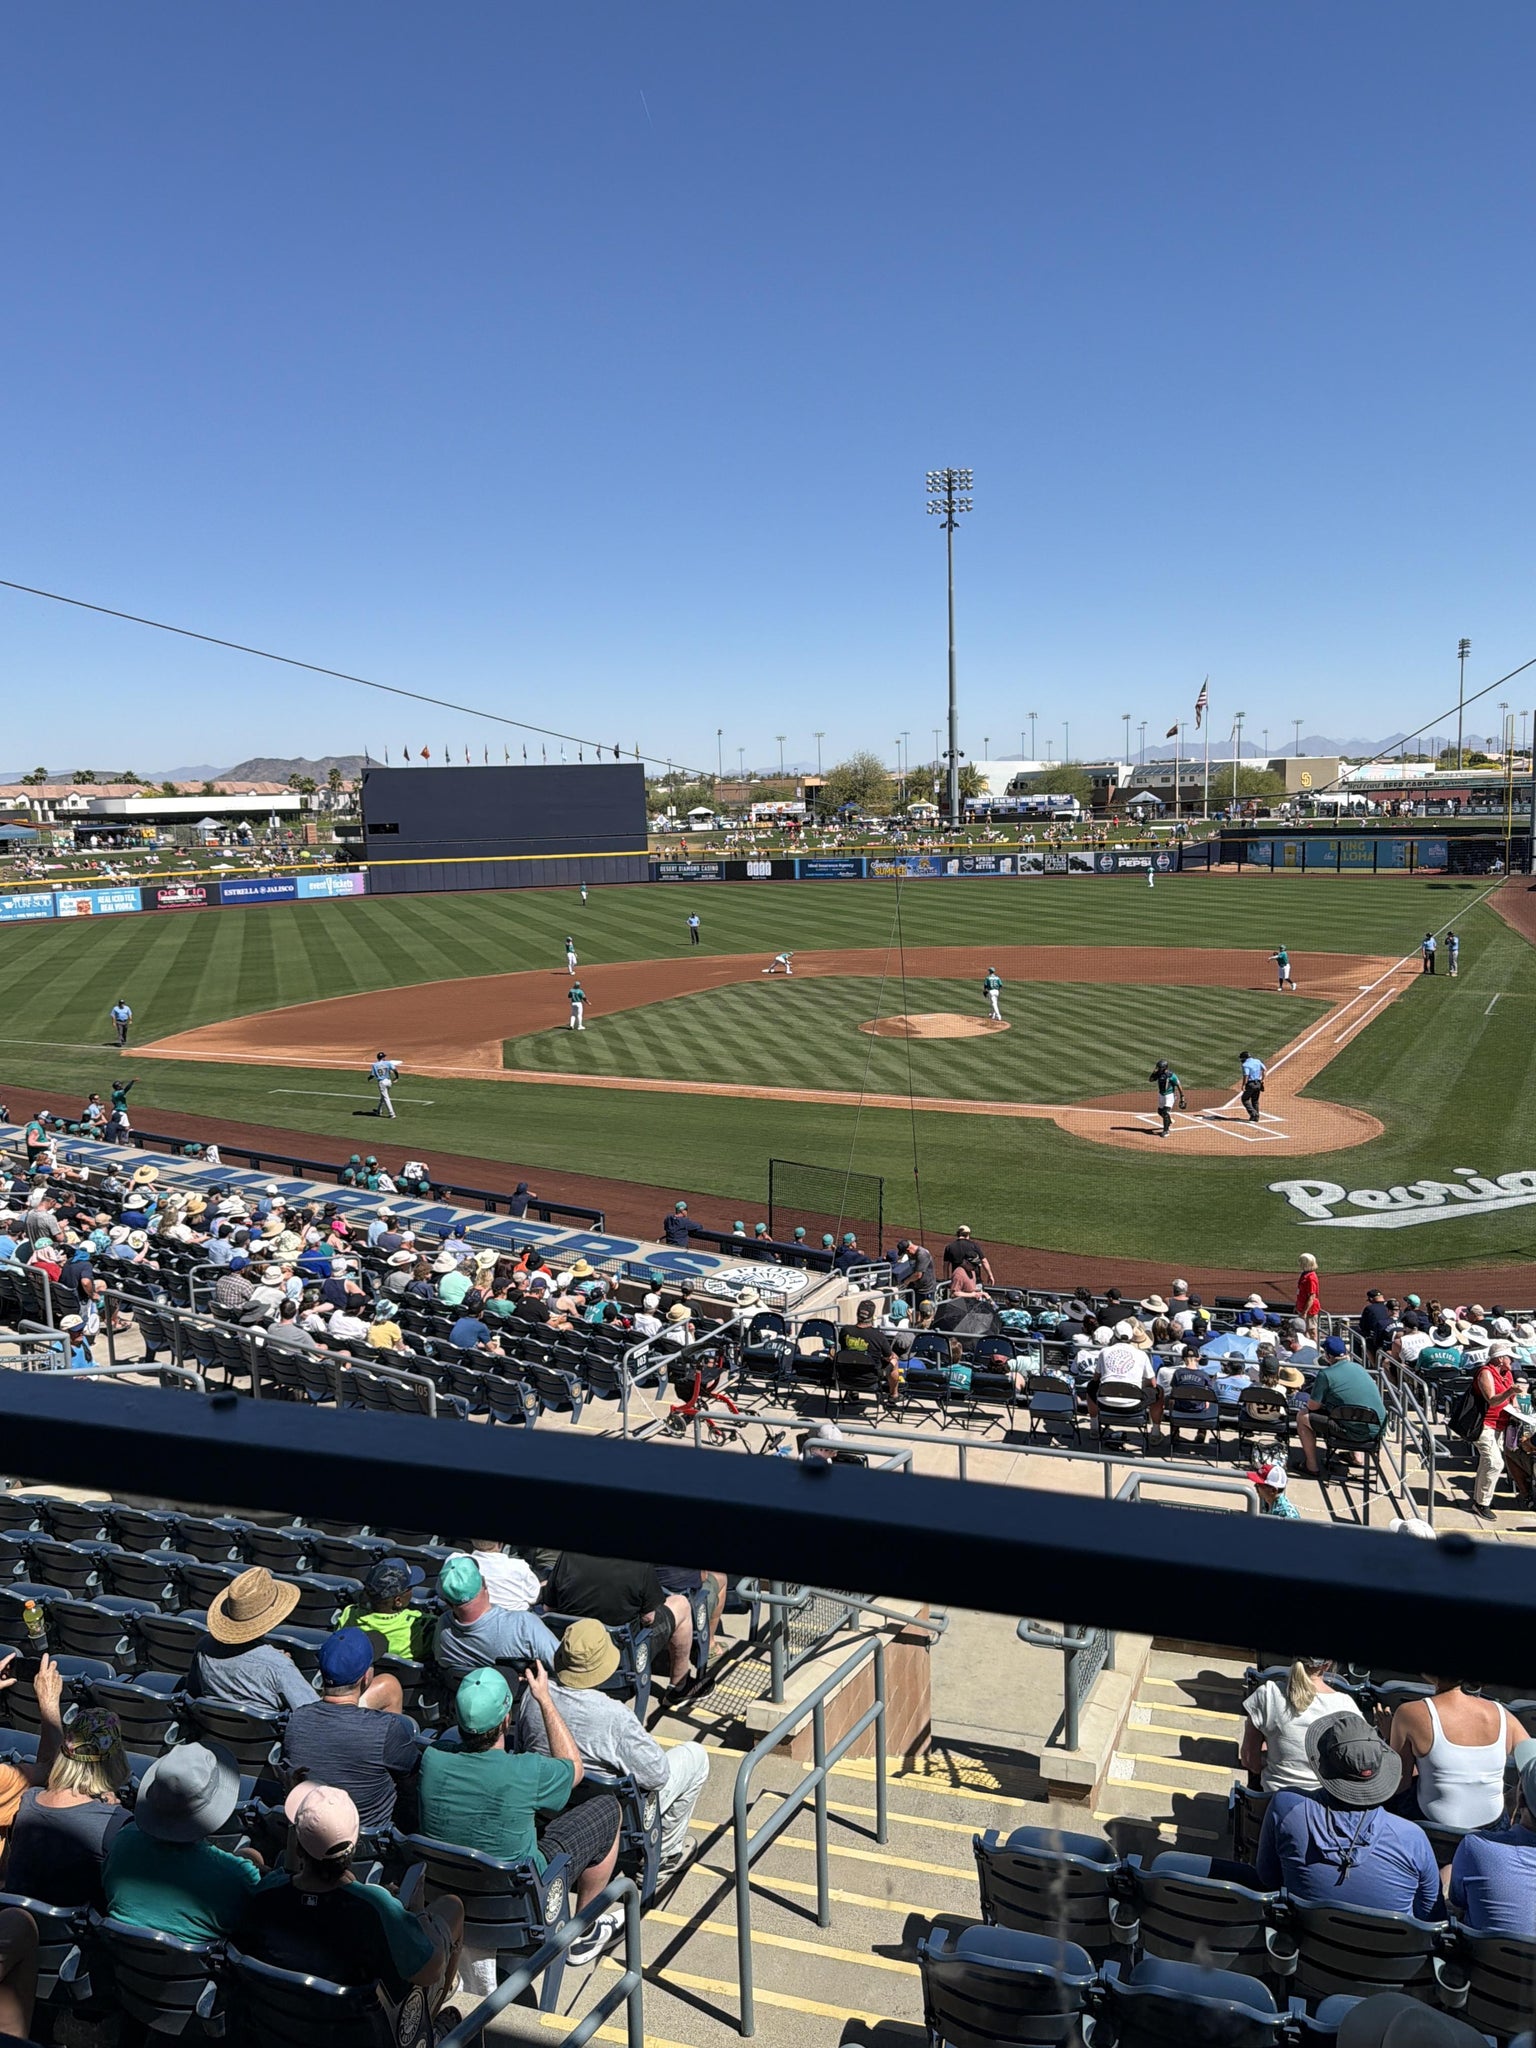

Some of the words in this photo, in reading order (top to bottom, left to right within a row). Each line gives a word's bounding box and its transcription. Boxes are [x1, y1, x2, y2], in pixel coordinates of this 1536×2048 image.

[874, 866, 907, 876] SUMMER
[223, 887, 259, 896] ESTRELLA
[266, 885, 295, 894] JALISCO
[309, 882, 326, 891] event
[332, 879, 354, 888] tickets
[97, 895, 111, 904] REAL
[111, 894, 124, 903] ICED
[100, 903, 114, 912] REAL
[636, 1355, 647, 1368] 103
[414, 1383, 429, 1398] 105
